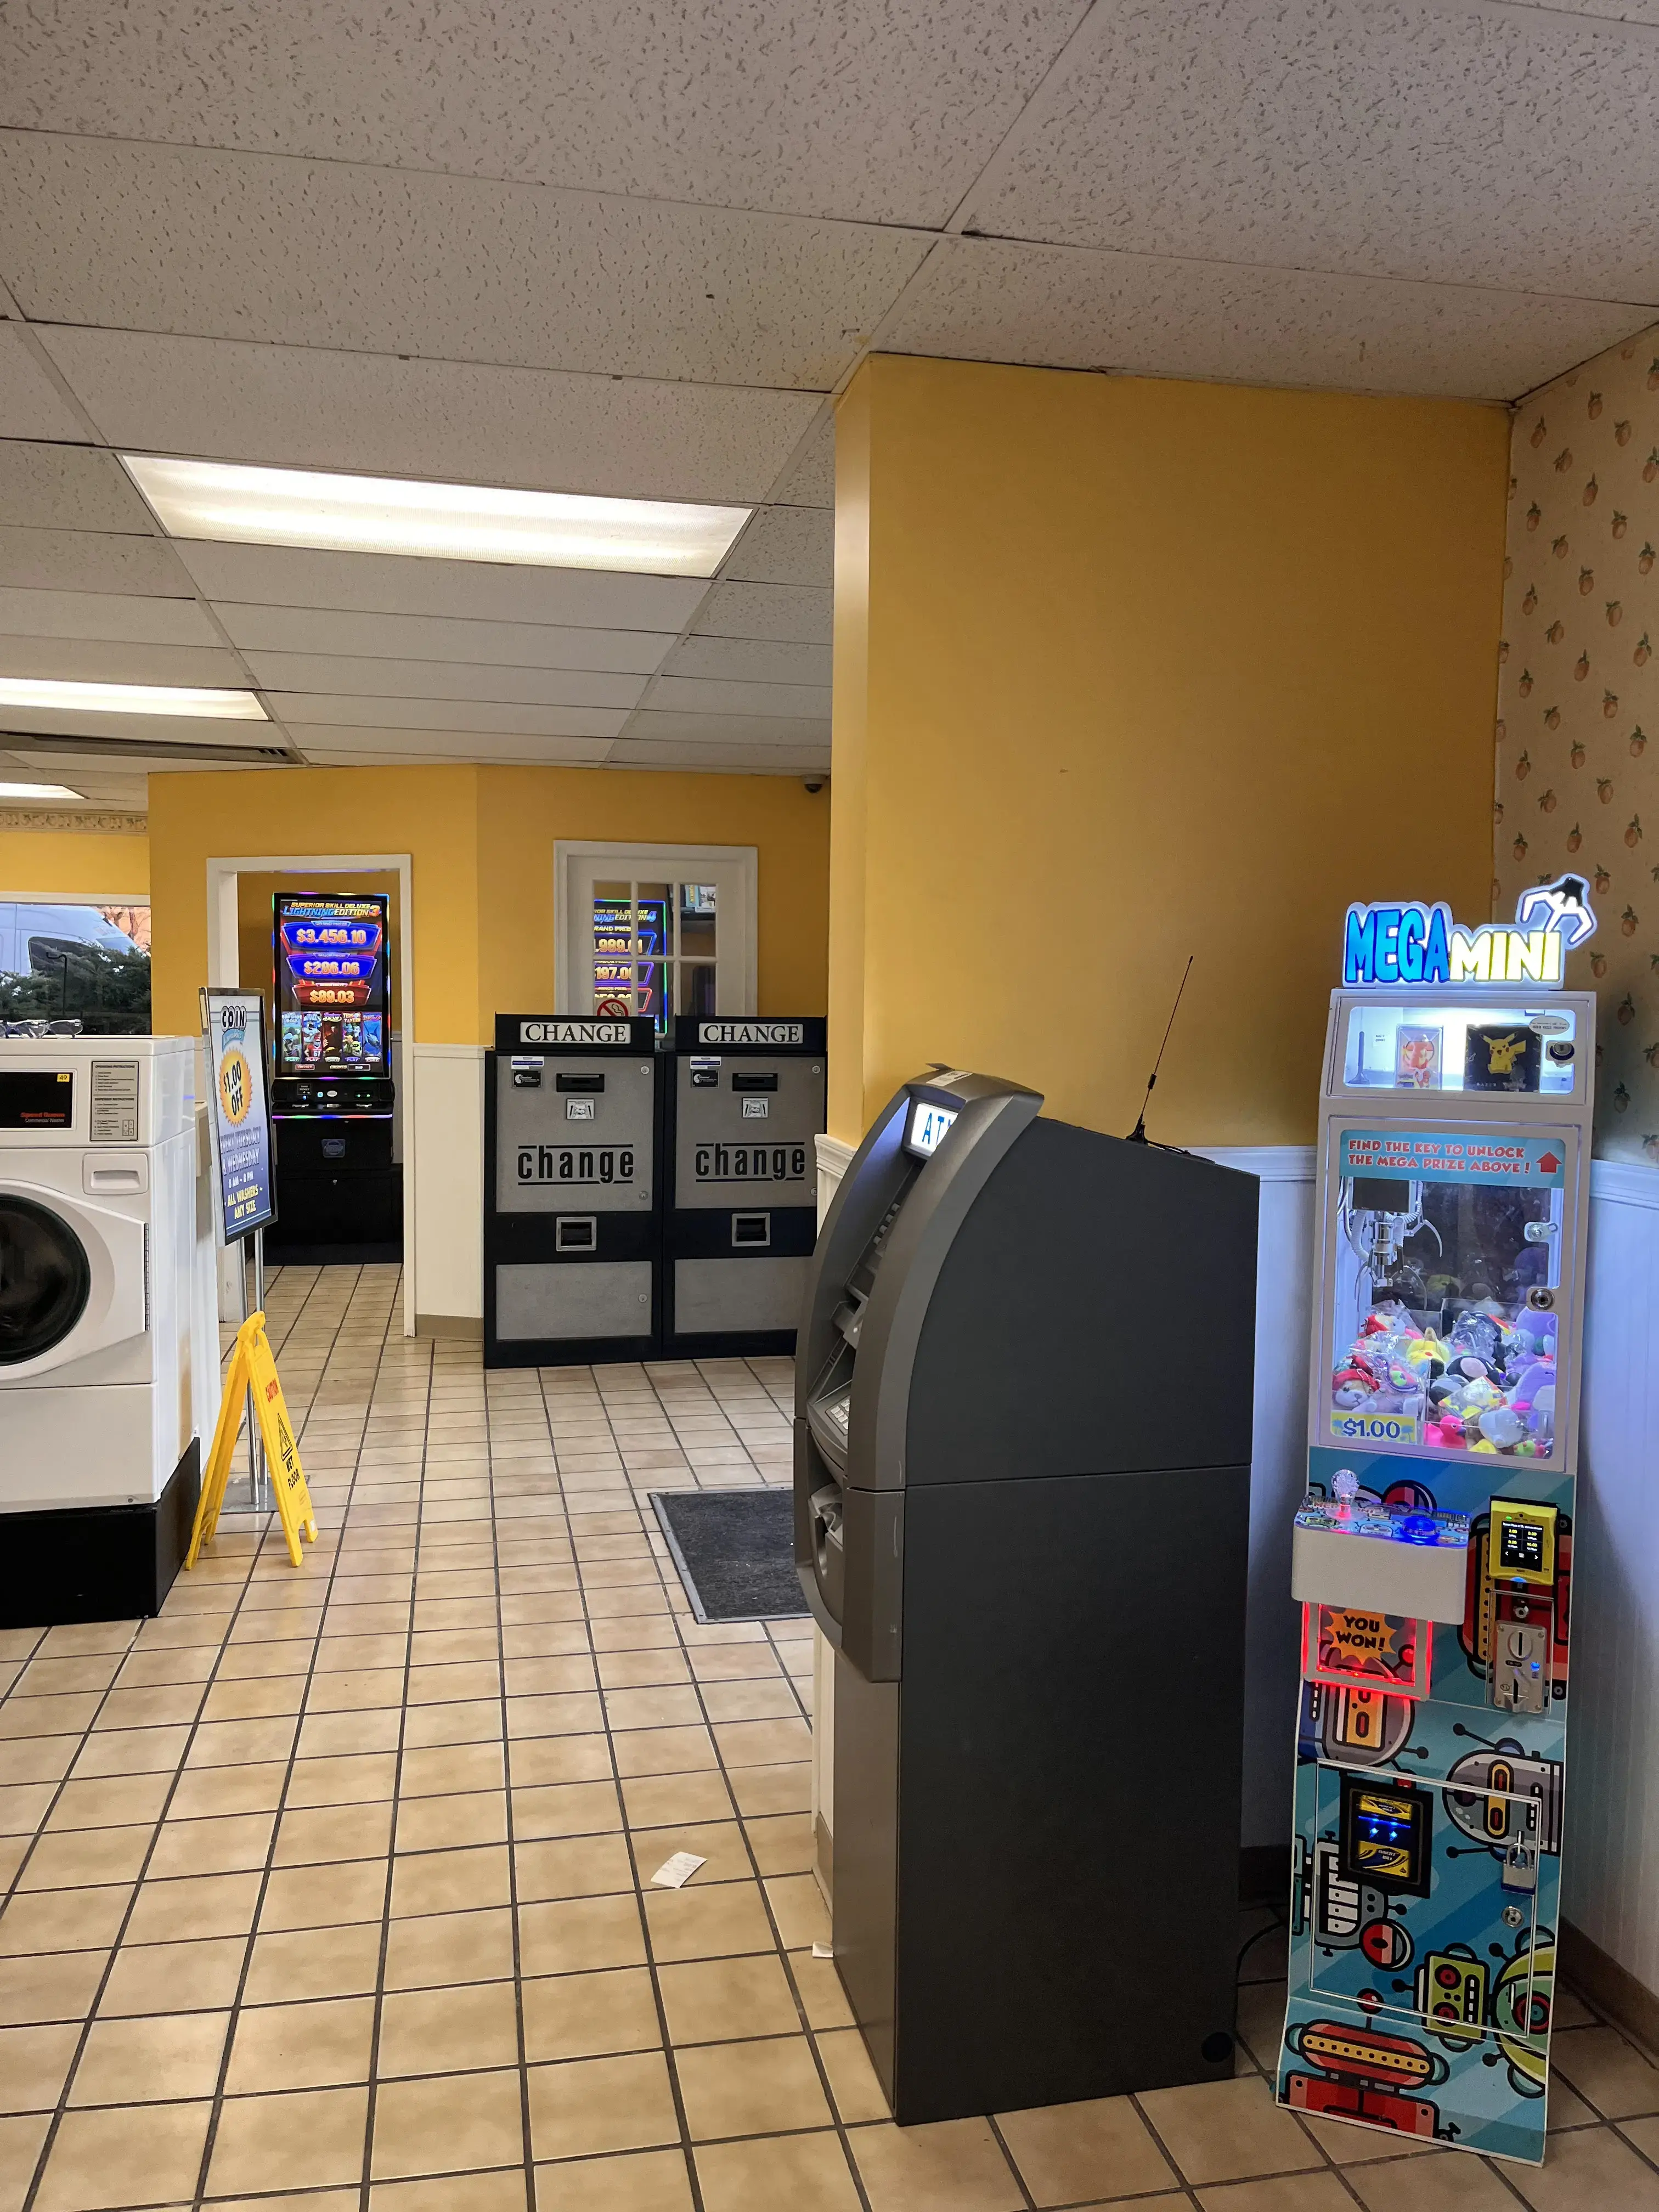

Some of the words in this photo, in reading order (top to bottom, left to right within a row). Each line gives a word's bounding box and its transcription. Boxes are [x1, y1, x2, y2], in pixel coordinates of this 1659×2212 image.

[283, 906, 334, 916] LIGHTNING
[1345, 908, 1450, 983] MEGA
[1449, 930, 1561, 982] MINI
[594, 966, 632, 980] 197.0
[222, 1011, 245, 1028] COIN
[525, 1024, 627, 1042] CHANGE
[704, 1025, 799, 1042] CHANGE
[223, 1060, 241, 1093] $1.00
[232, 1086, 242, 1115] OFF
[235, 1126, 261, 1149] TUESDAY
[922, 1112, 952, 1146] AT
[1349, 1139, 1381, 1151] FIND
[1385, 1141, 1410, 1152] THE
[1414, 1143, 1442, 1154] KEY
[1445, 1144, 1463, 1155] TO
[1468, 1145, 1525, 1158] UNLOCK
[227, 1147, 259, 1174] WEDNESDAY
[518, 1145, 633, 1183] change
[696, 1143, 805, 1180] change
[1348, 1154, 1373, 1165] THE
[1377, 1155, 1418, 1167] MEGA
[1423, 1158, 1465, 1170] PRIZE
[247, 1171, 254, 1182] PM
[227, 1193, 236, 1207] ALL
[236, 1184, 259, 1203] WASHERS
[234, 1204, 245, 1220] ANY
[245, 1199, 257, 1215] SIZE
[1342, 1418, 1401, 1438] $1.00
[285, 1455, 294, 1472] WET
[287, 1468, 300, 1490] FLOOR
[1343, 1615, 1380, 1633] YOU
[1335, 1631, 1386, 1651] WON!
